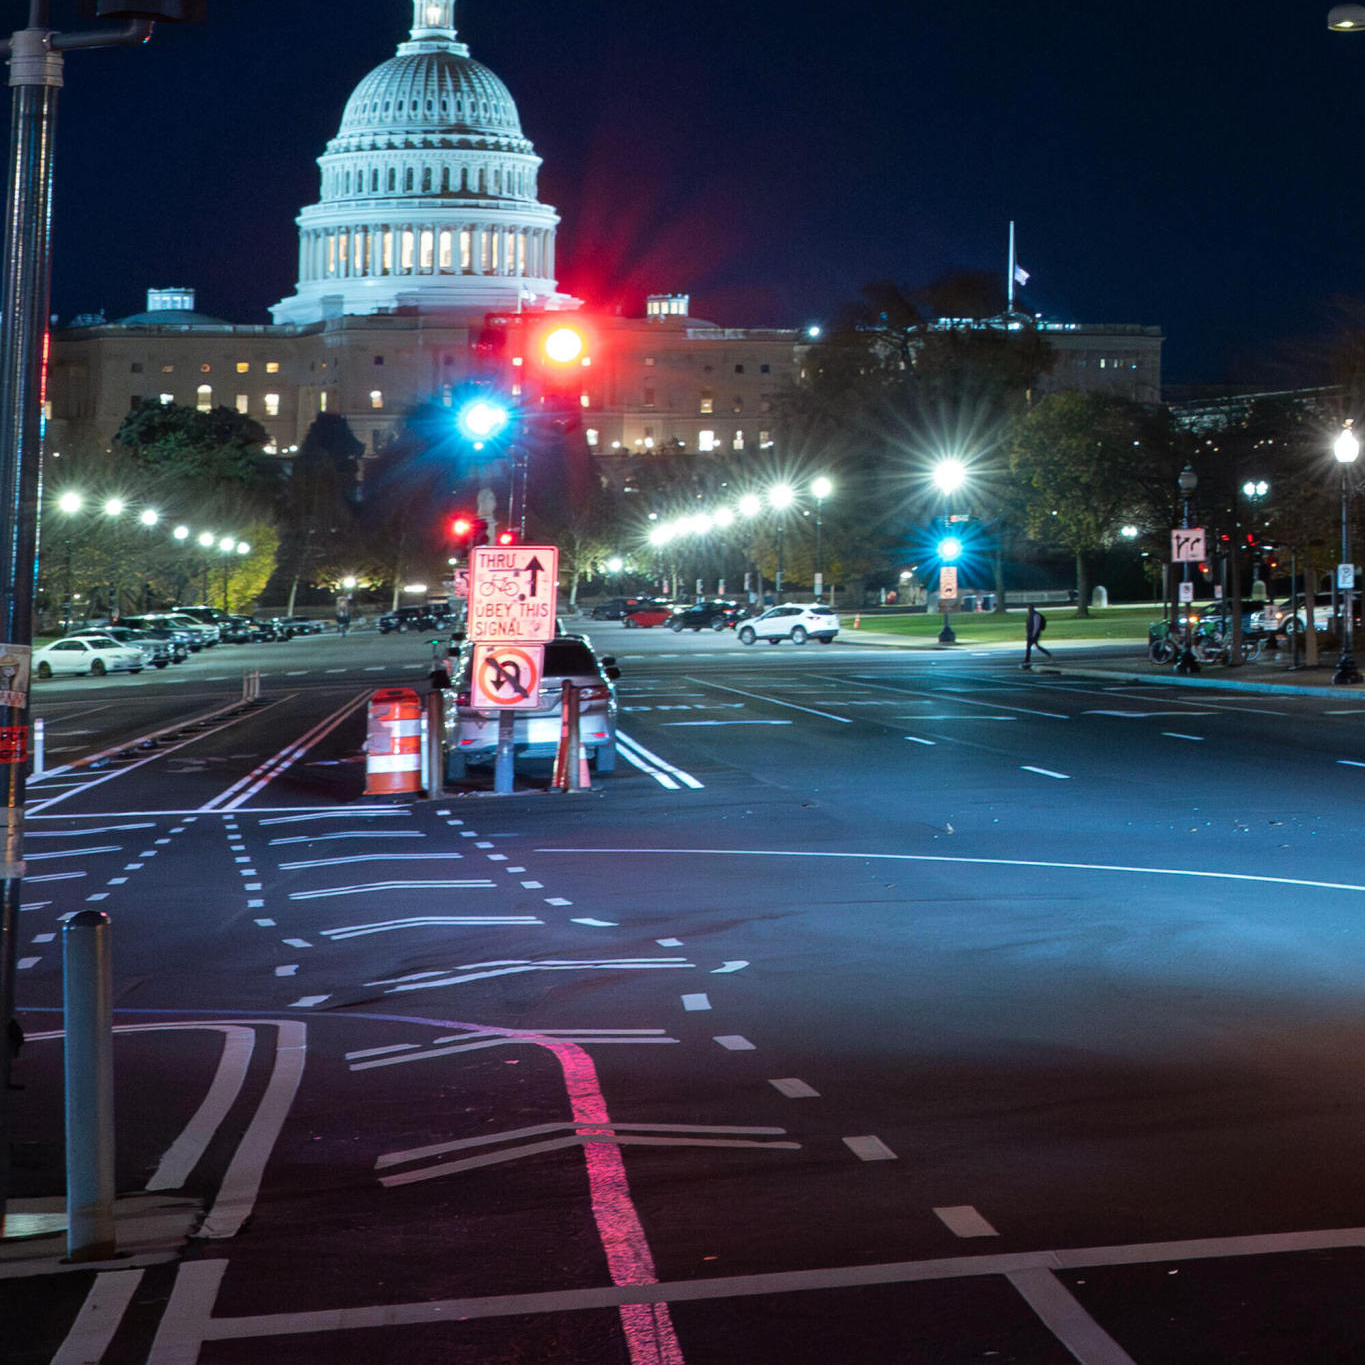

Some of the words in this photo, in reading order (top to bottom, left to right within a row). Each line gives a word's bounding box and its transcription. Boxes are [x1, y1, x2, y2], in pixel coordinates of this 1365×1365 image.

[480, 553, 517, 568] THRU
[519, 602, 549, 617] THIS
[475, 621, 523, 636] SIGNAL
